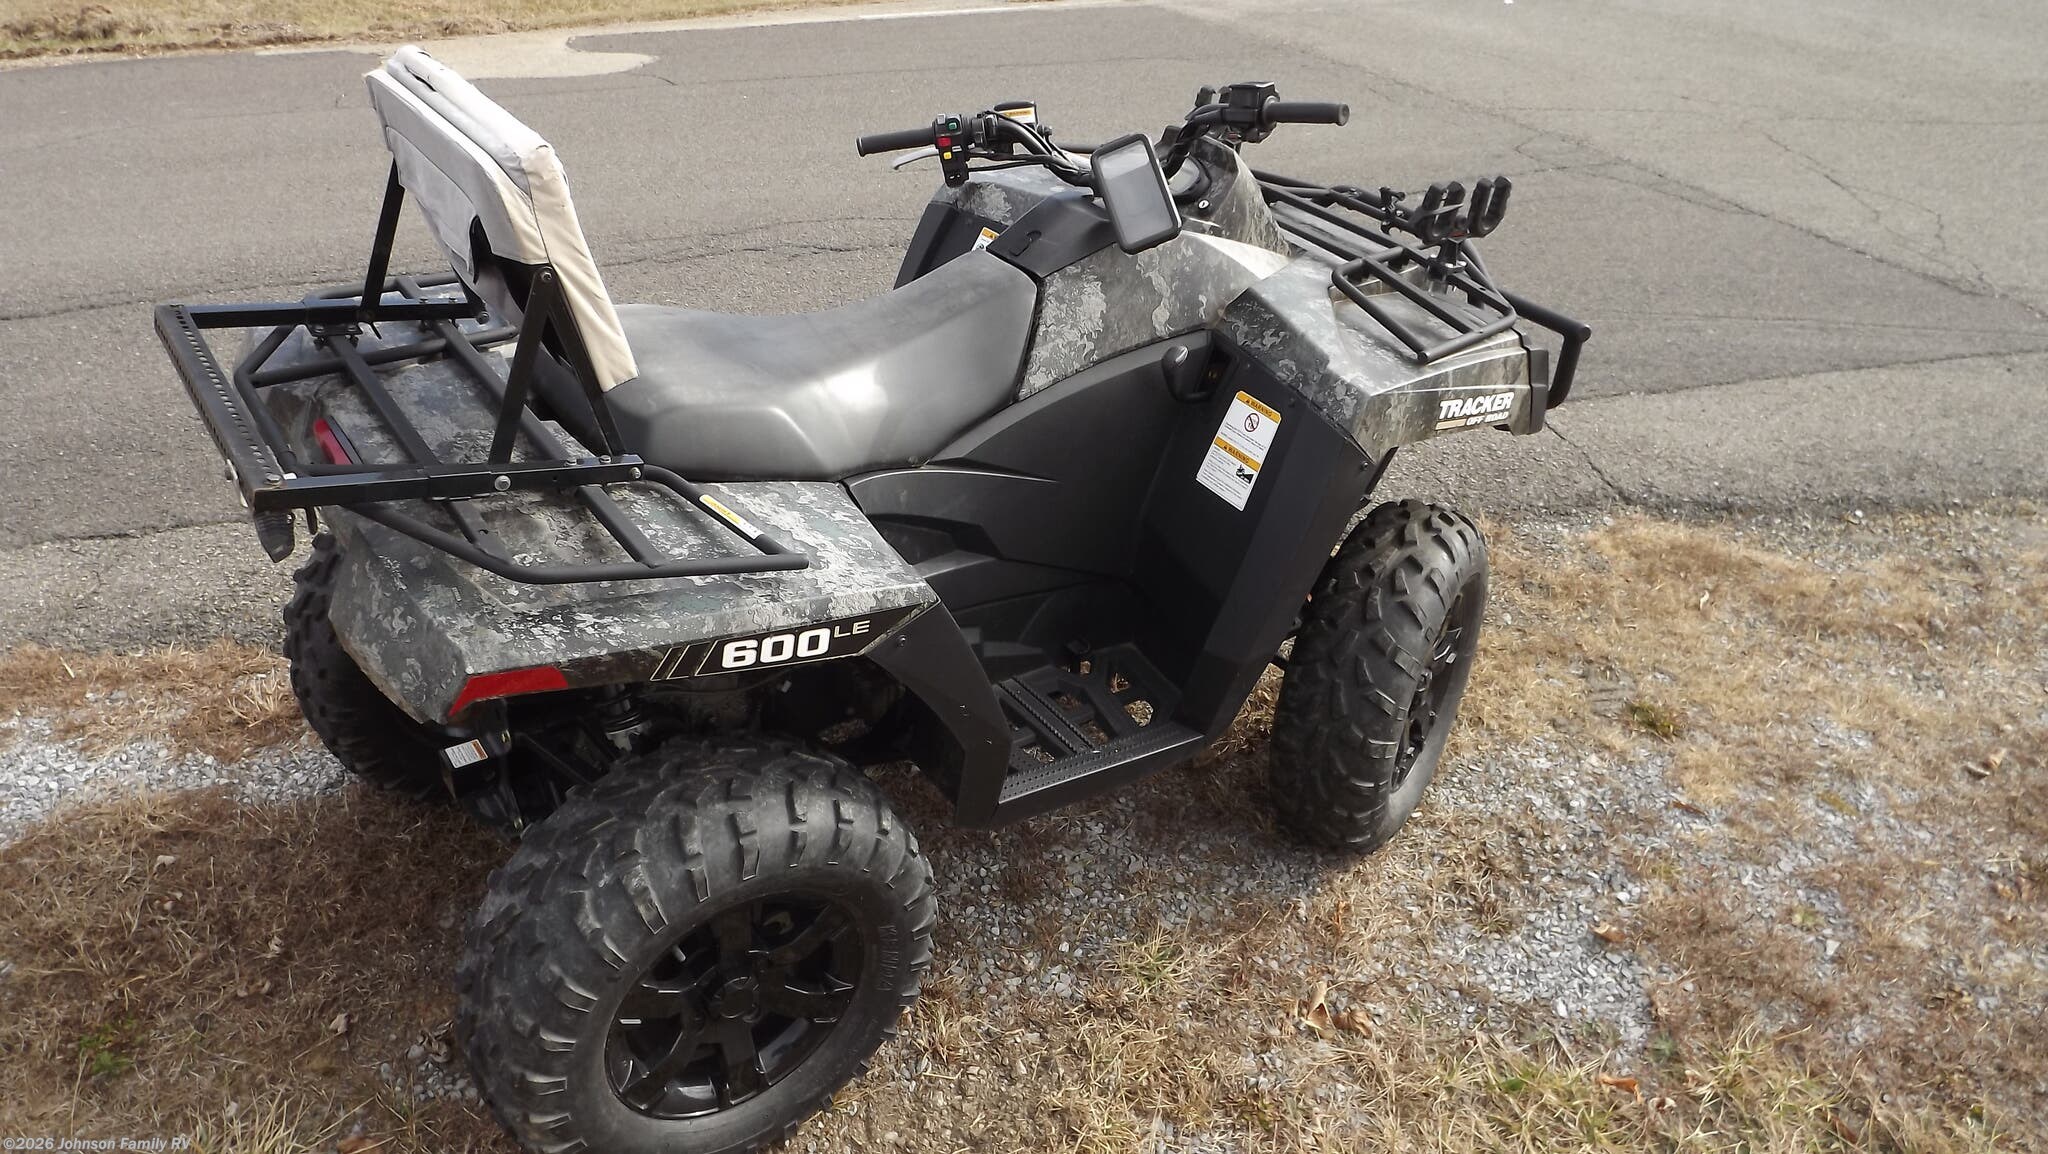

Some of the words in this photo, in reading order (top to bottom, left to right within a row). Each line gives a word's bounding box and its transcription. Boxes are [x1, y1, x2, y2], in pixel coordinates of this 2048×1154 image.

[1438, 392, 1515, 419] TRACKER
[1466, 415, 1486, 426] OFF
[1485, 411, 1509, 423] ROAD
[721, 627, 831, 669] 600
[833, 619, 871, 638] LE
